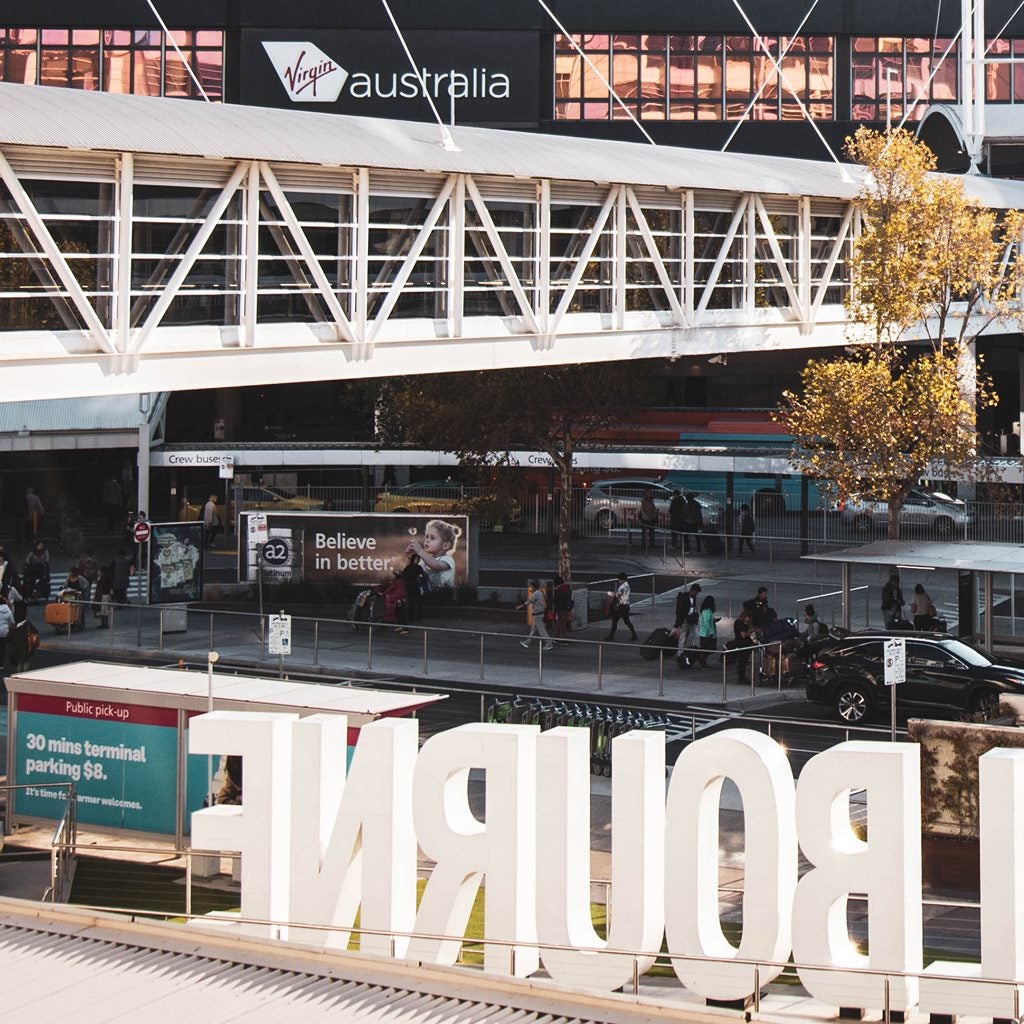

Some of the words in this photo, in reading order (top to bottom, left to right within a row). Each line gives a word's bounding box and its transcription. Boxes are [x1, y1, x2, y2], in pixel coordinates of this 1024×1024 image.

[285, 51, 337, 97] Virgin
[350, 67, 510, 98] australia
[168, 454, 193, 464] Crew
[265, 544, 287, 559] a2
[316, 533, 376, 550] Believe
[316, 553, 331, 570] in
[66, 701, 93, 715] Public
[95, 705, 129, 720] pick-up
[27, 733, 46, 751] 30
[48, 737, 82, 755] mins
[84, 740, 146, 762] terminal
[26, 758, 81, 781] parking
[84, 762, 107, 781] $8.
[25, 787, 40, 796] It's
[40, 789, 57, 800] time
[101, 796, 143, 810] welcomes.
